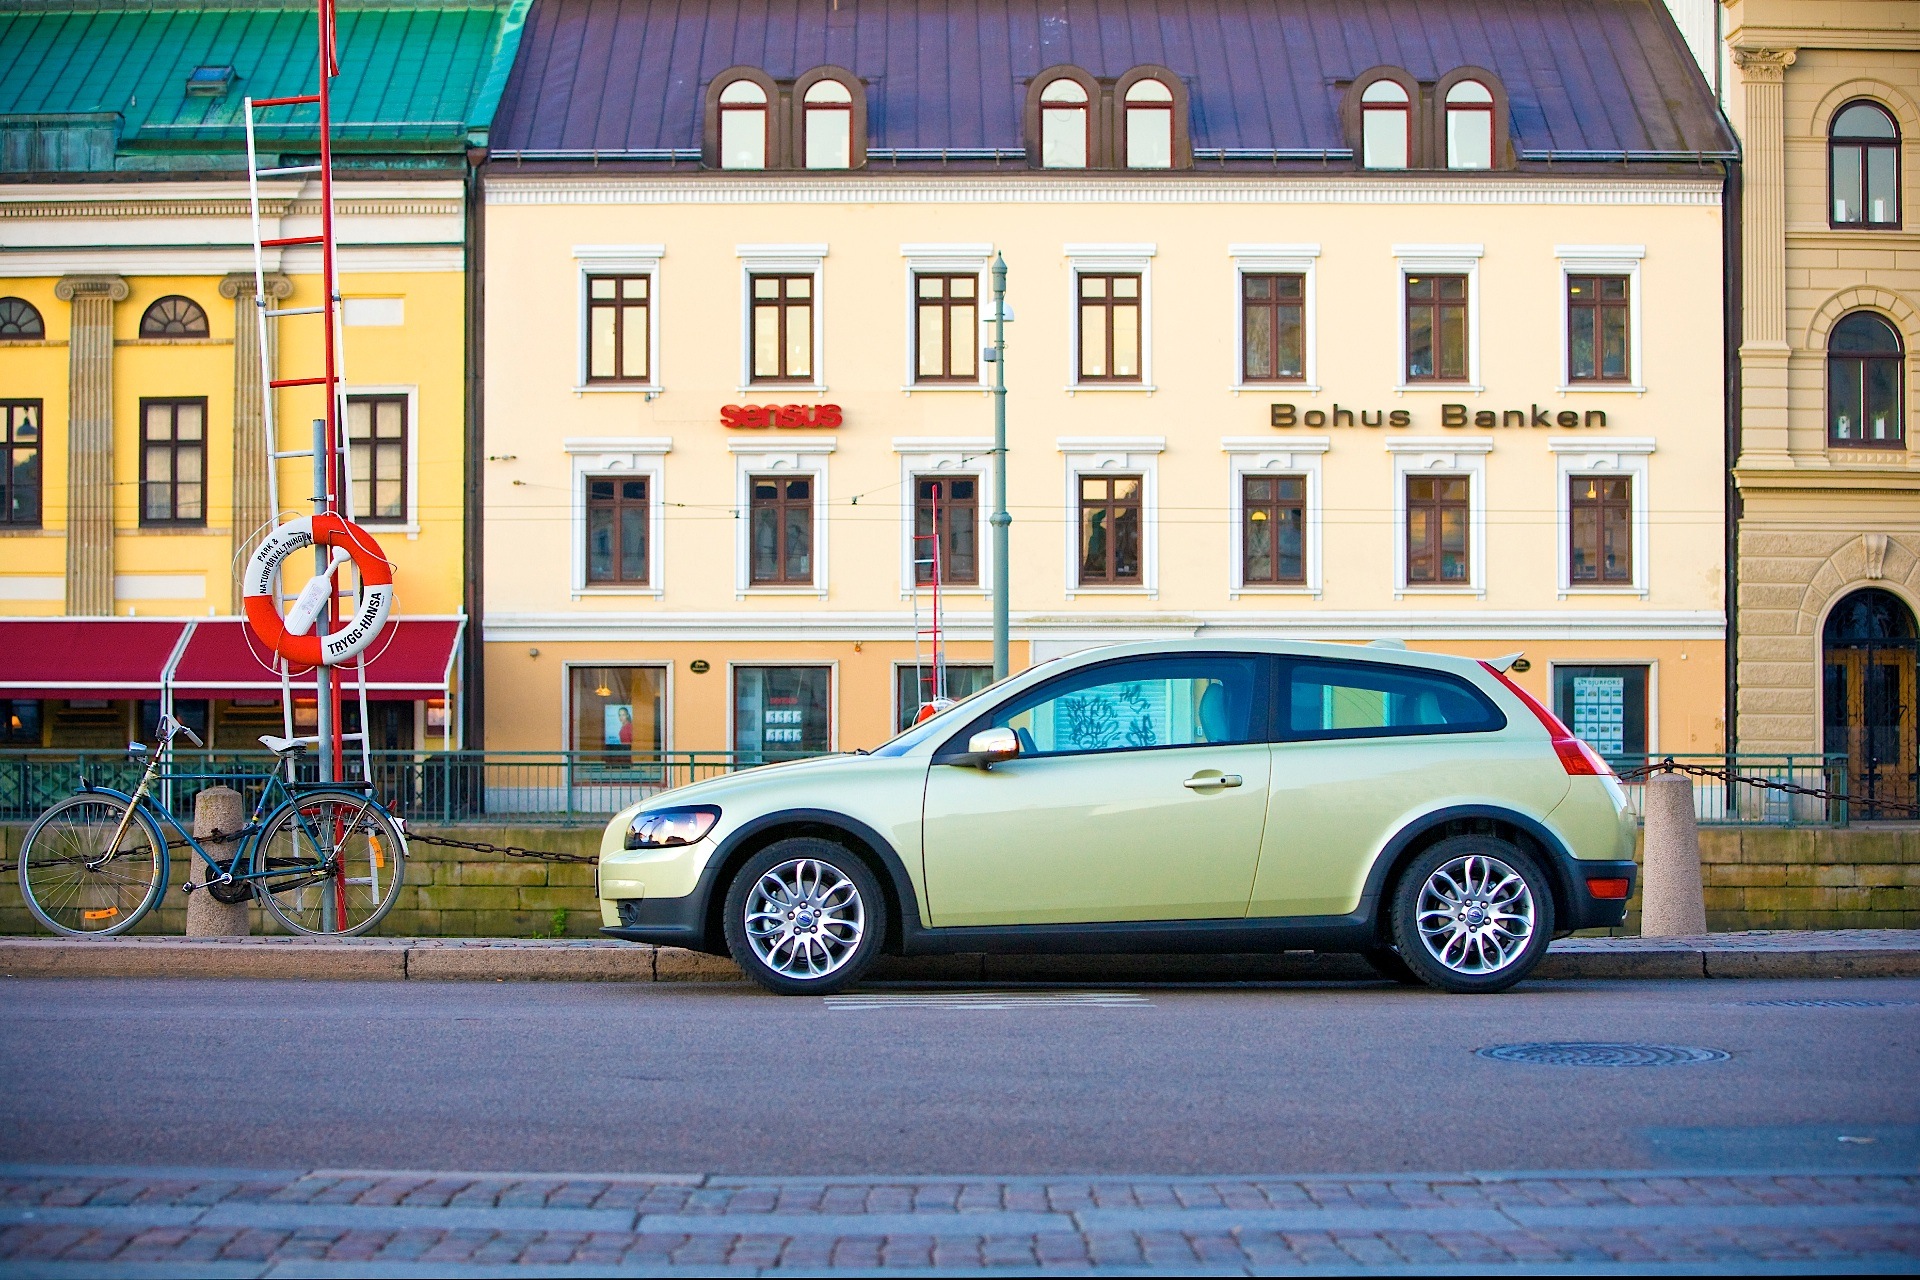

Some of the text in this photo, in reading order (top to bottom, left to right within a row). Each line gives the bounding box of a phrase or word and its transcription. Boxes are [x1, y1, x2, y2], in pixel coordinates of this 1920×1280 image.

[720, 403, 843, 428] sensus
[1270, 403, 1607, 428] Bohus Banken
[257, 543, 274, 562] PARK
[327, 592, 382, 655] TRYGG-HANSA
